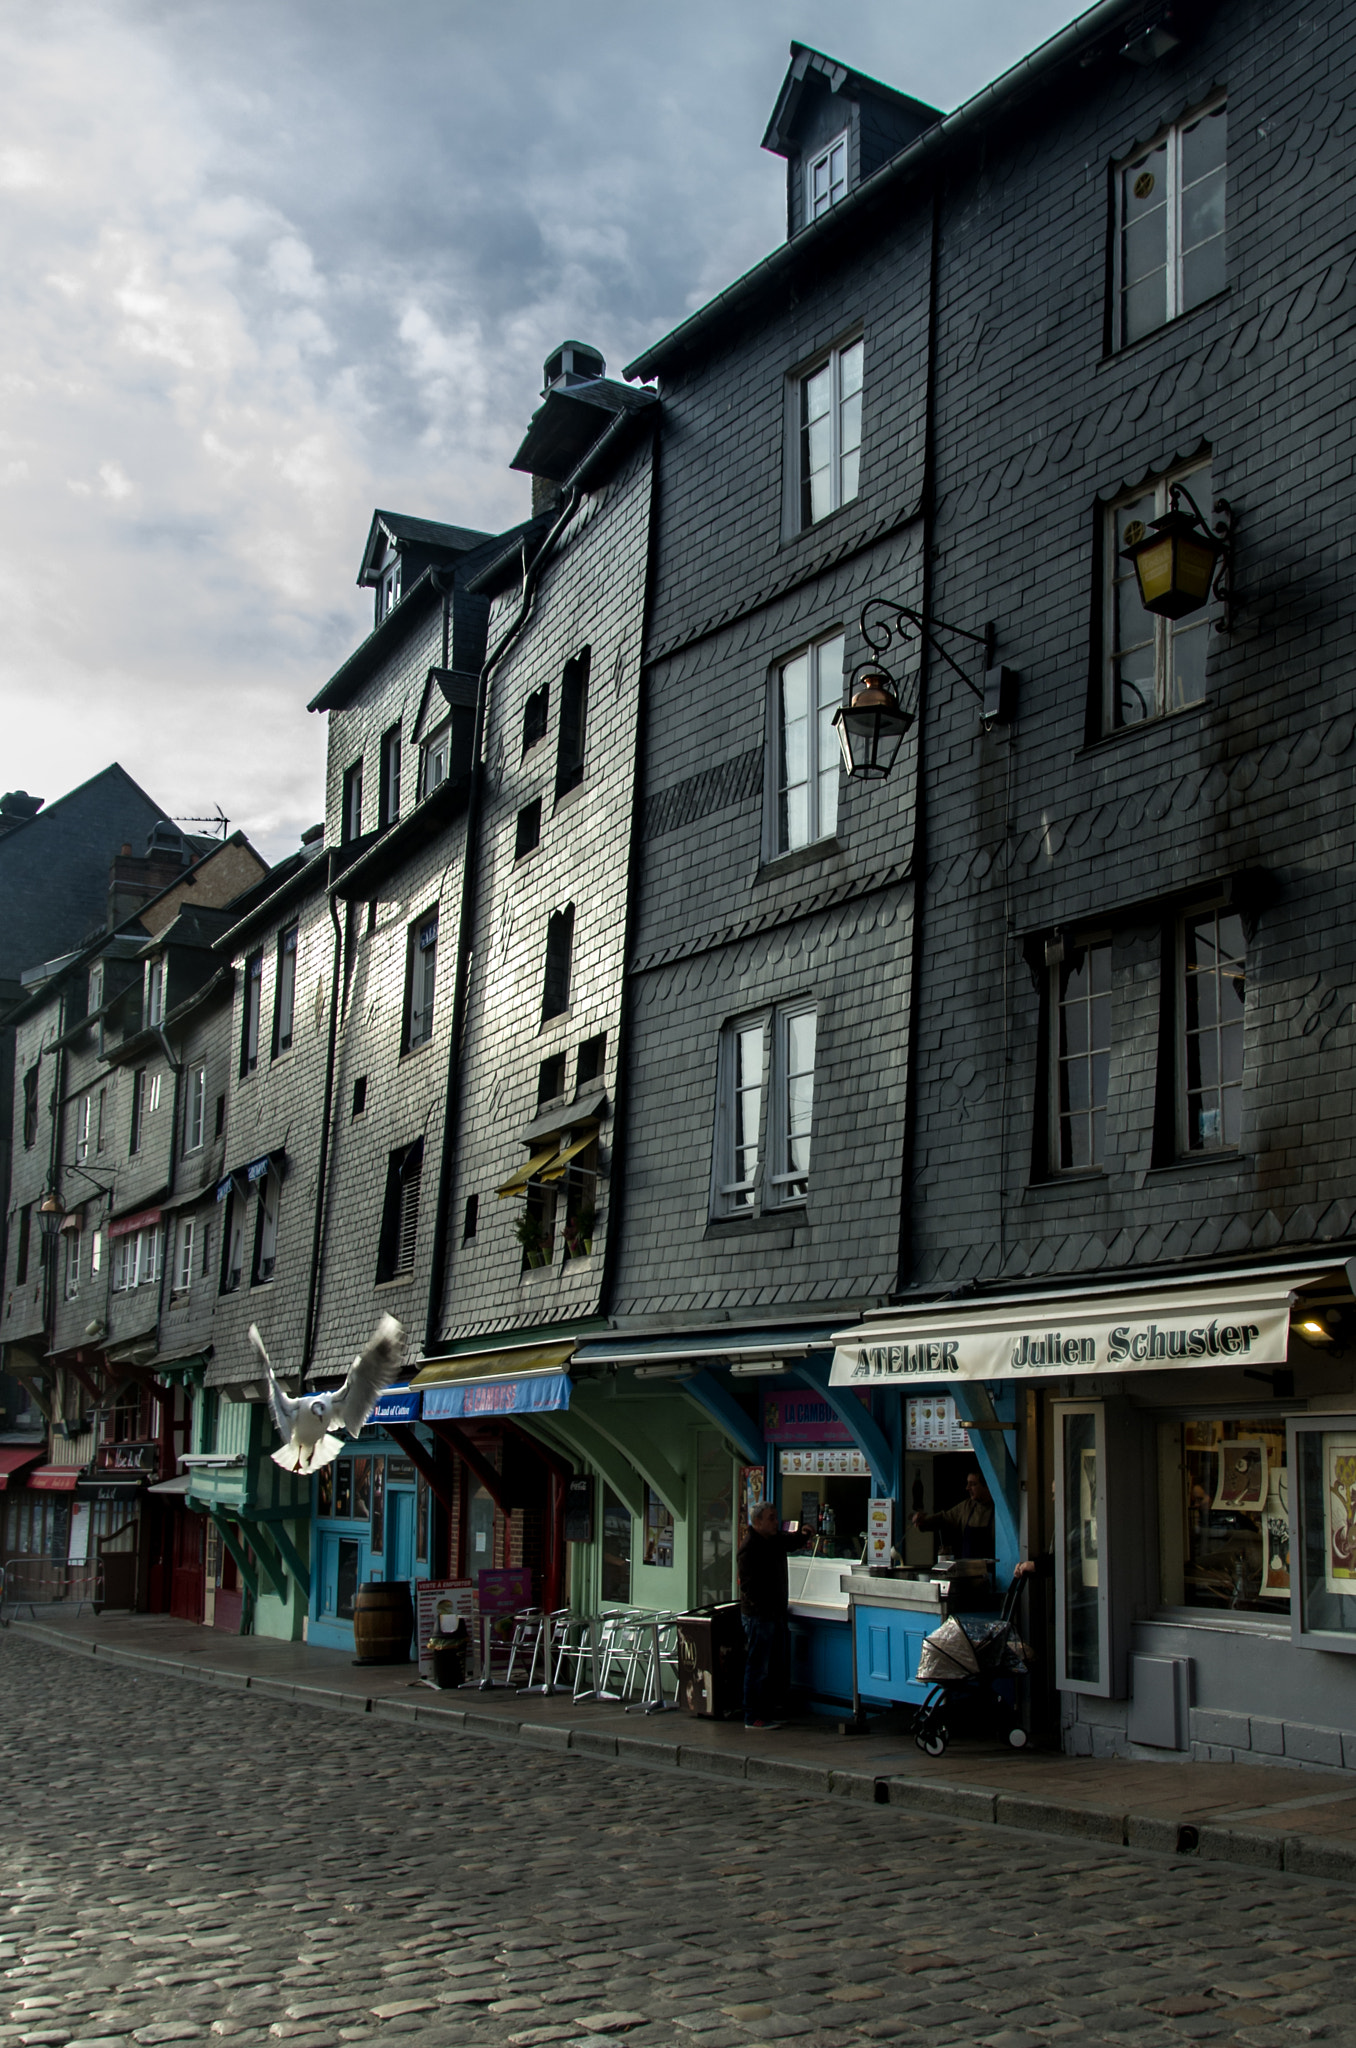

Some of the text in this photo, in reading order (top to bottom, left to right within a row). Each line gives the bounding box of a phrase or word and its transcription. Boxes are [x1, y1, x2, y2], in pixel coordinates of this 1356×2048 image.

[851, 1318, 1259, 1378] ATELIER Julien Schuster
[377, 1404, 410, 1416] Land of Cotton
[464, 1388, 474, 1412] LA
[785, 1402, 842, 1424] LA CAMBUS
